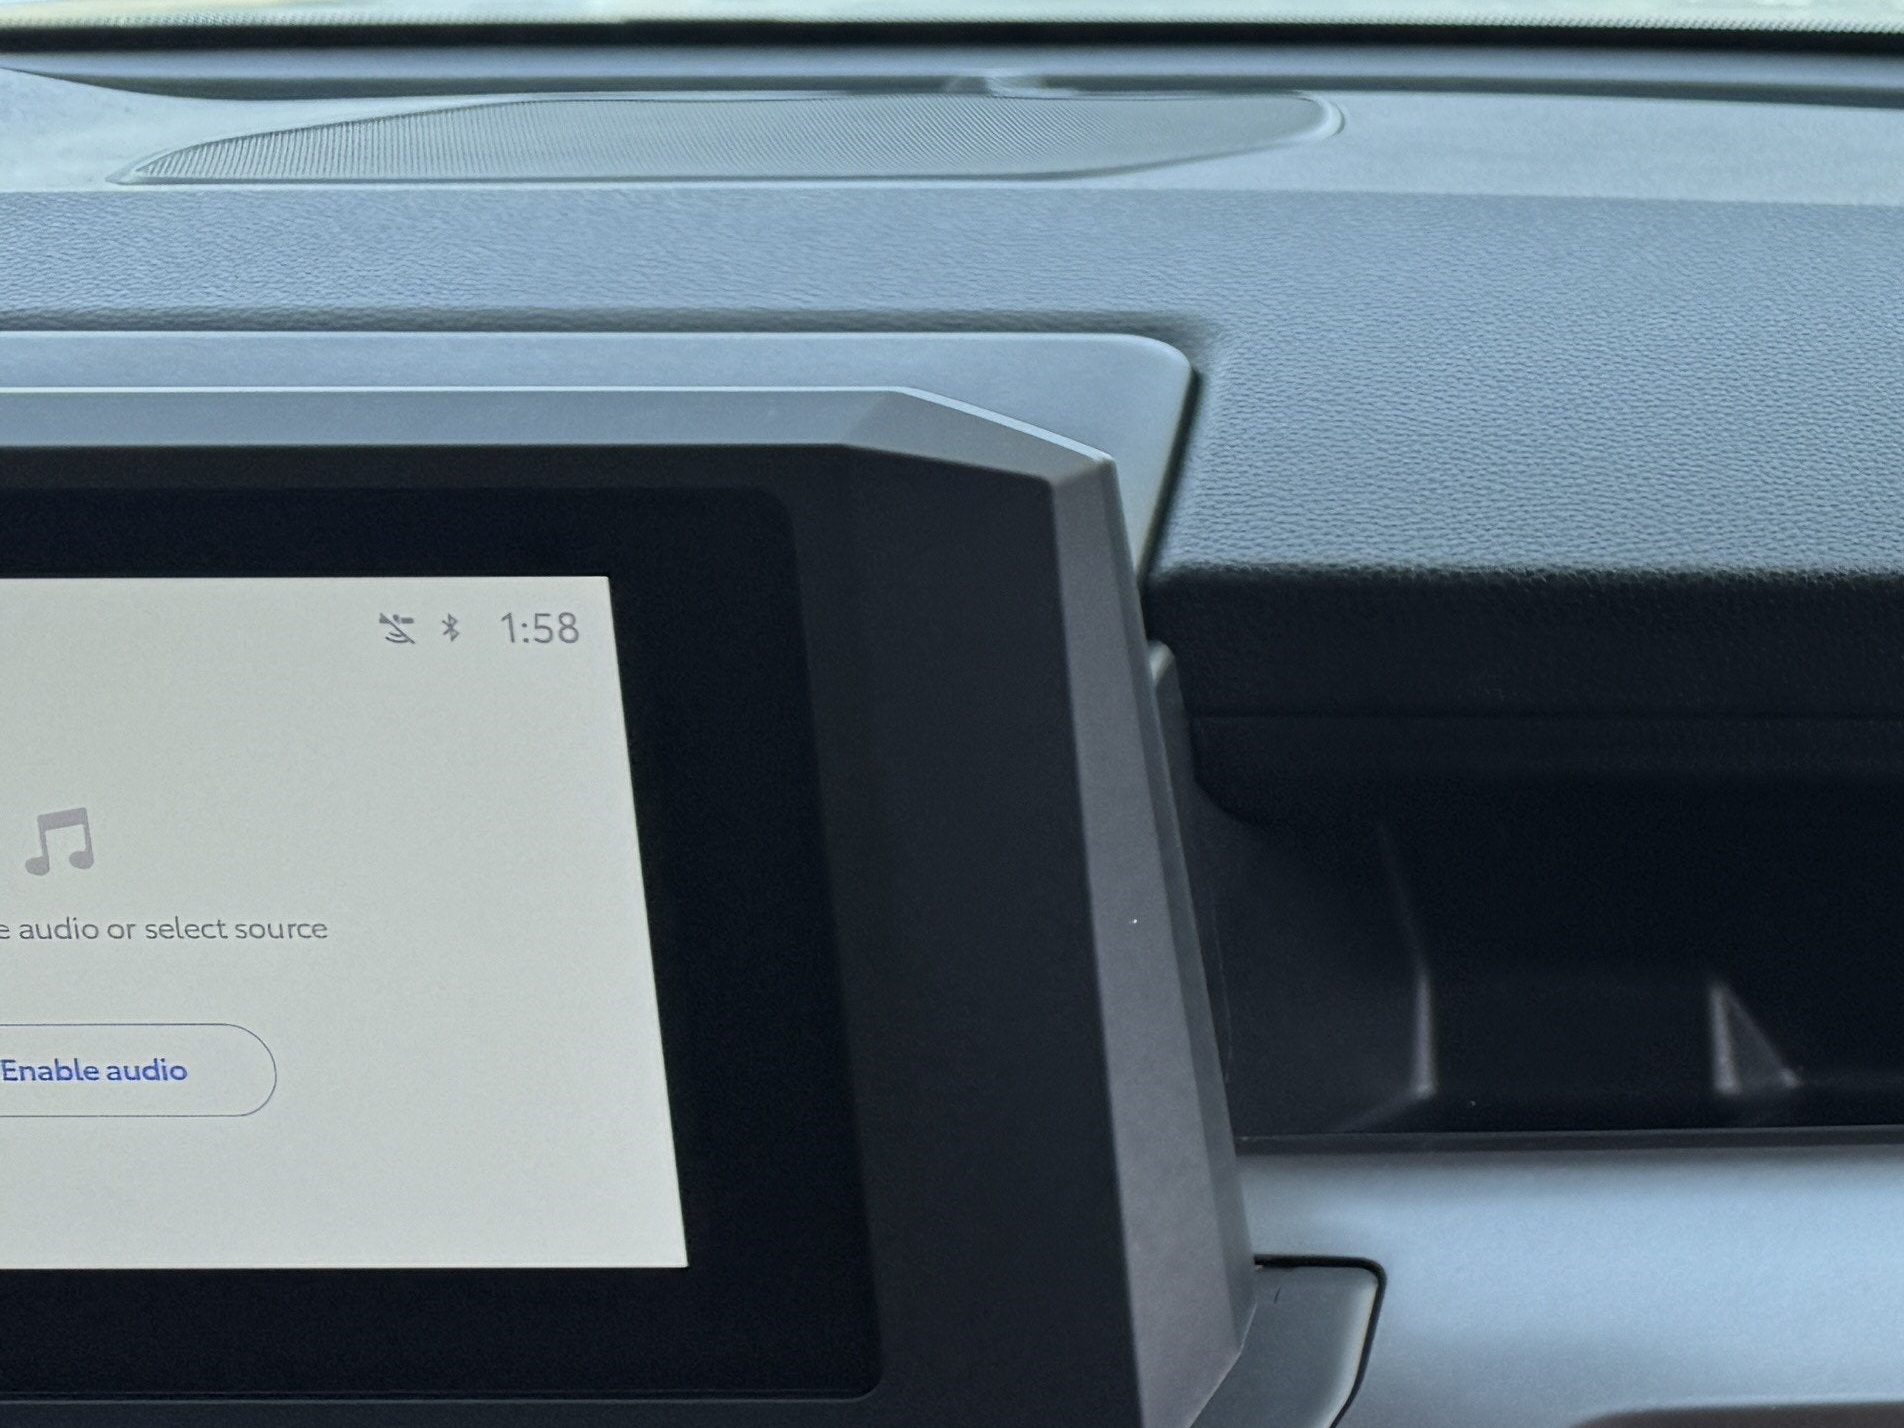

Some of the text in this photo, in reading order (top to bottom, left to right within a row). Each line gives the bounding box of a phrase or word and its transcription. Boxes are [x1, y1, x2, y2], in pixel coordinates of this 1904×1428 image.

[499, 611, 581, 645] 1:58
[18, 916, 100, 941] audio
[106, 922, 137, 940] or
[144, 915, 229, 940] select
[234, 922, 329, 940] source
[0, 1057, 189, 1082] Enable audio
